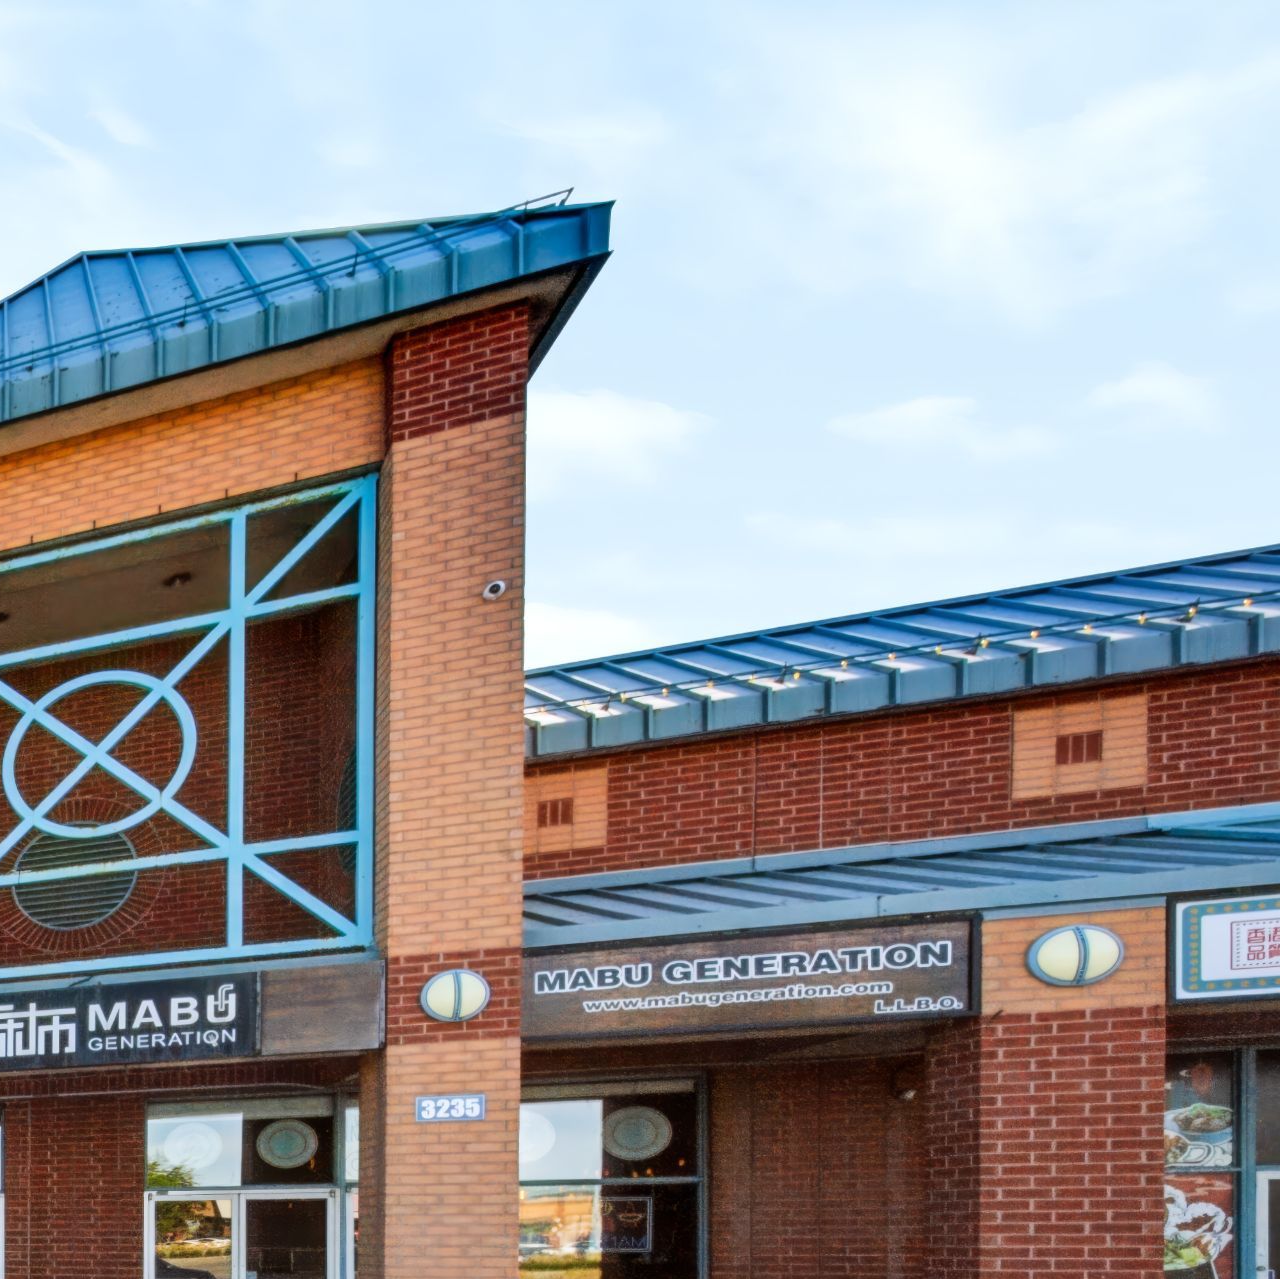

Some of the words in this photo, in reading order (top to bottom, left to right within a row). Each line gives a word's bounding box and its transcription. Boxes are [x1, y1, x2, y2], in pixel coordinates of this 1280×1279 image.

[534, 962, 653, 994] MABU
[662, 940, 952, 984] GENERATION
[583, 980, 893, 1013] www.mabugeneration.com
[873, 996, 964, 1014] L.L.B.O.
[88, 1028, 237, 1051] GENERATION
[421, 1098, 481, 1119] 3235
